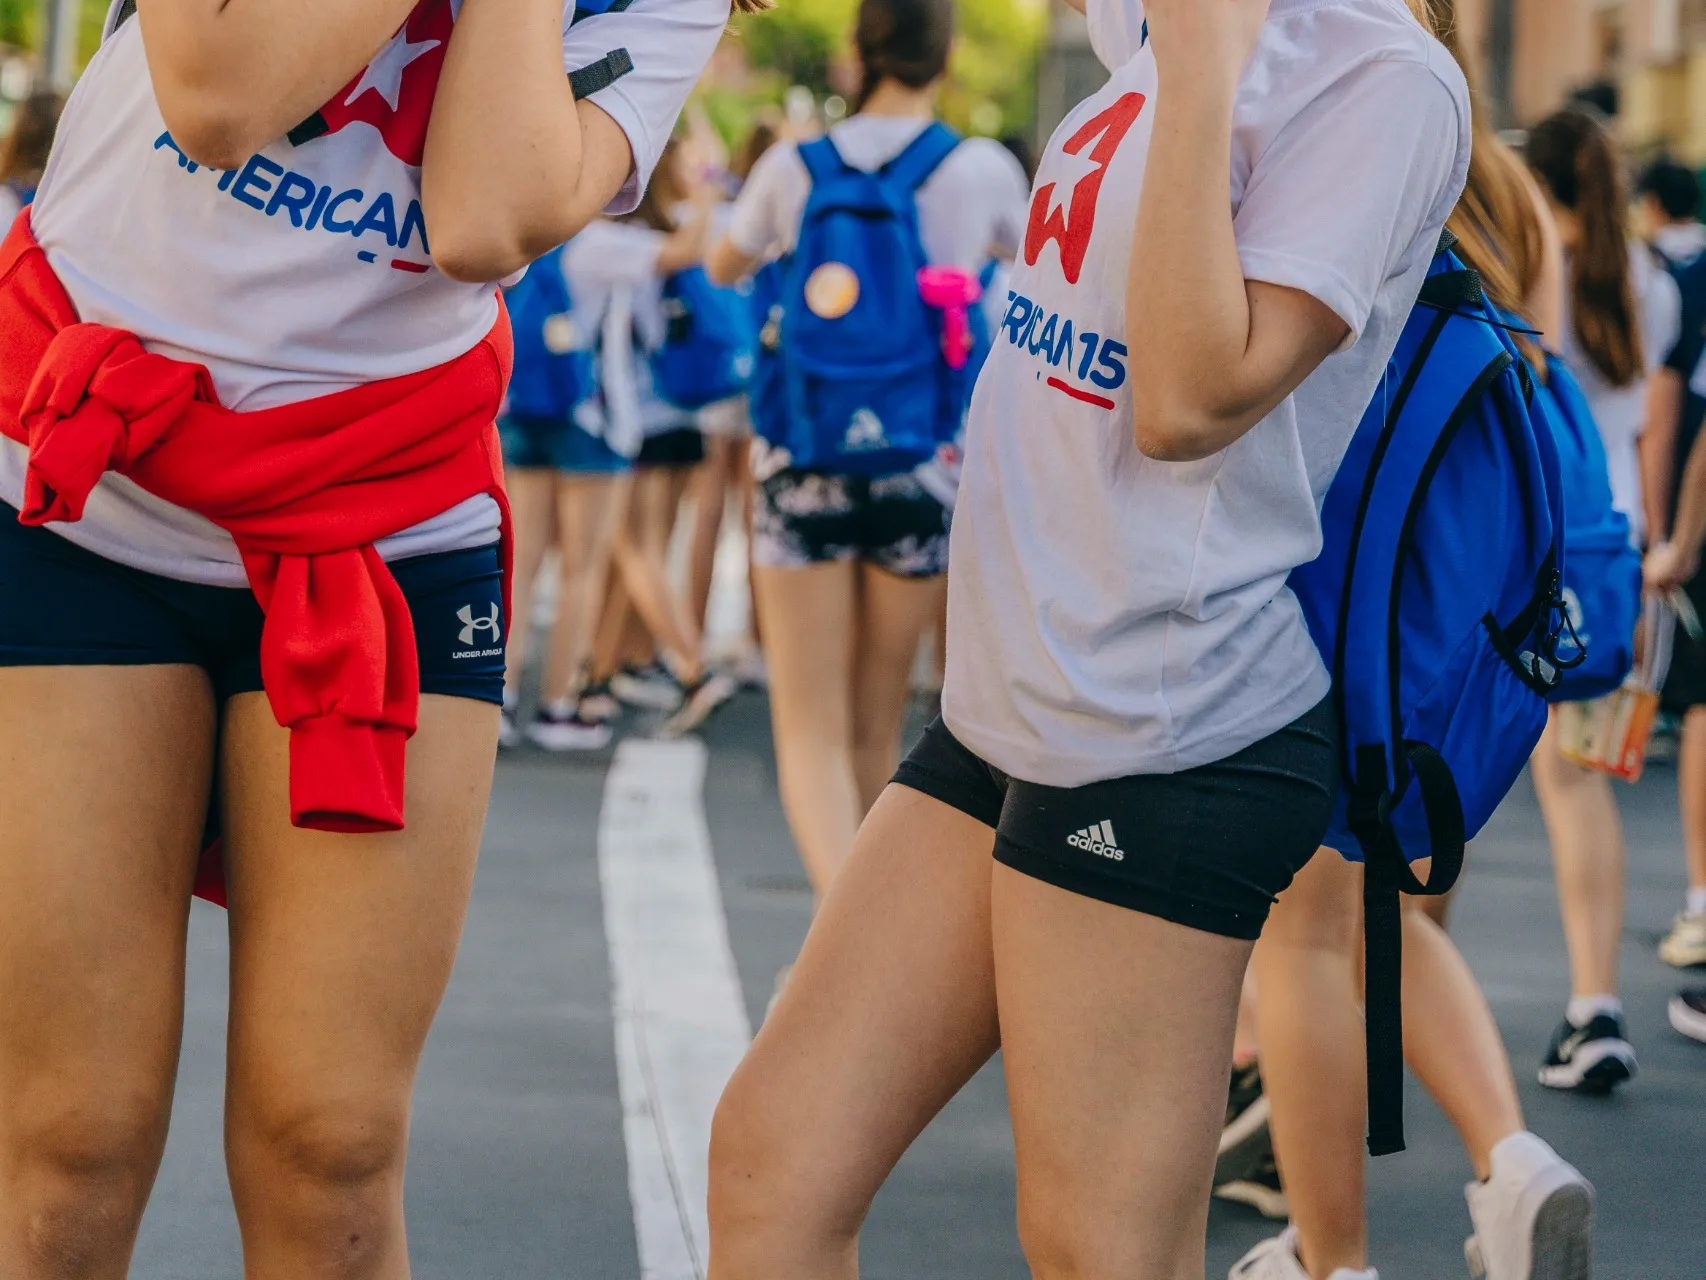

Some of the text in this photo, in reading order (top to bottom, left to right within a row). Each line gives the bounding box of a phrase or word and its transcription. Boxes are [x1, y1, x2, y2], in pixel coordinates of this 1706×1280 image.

[153, 130, 431, 255] ERICAN
[481, 648, 502, 656] ARMOUR
[1067, 834, 1124, 861] adidas
